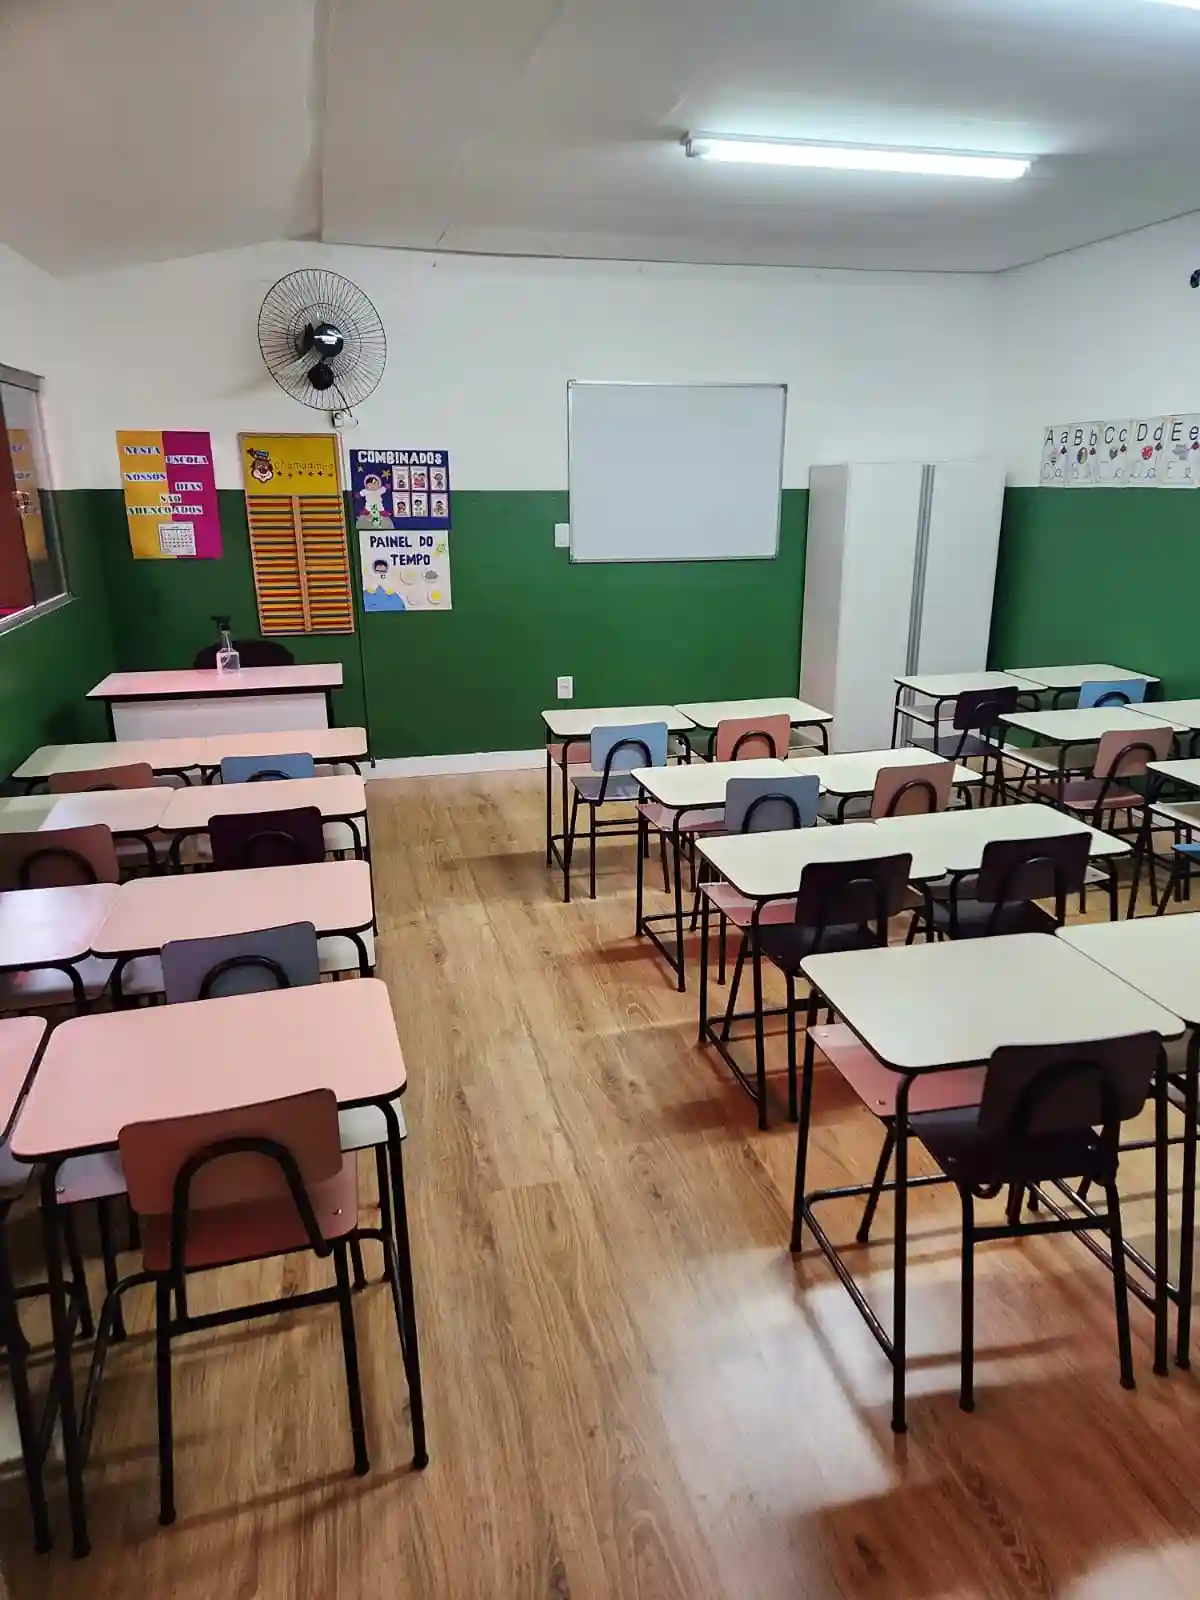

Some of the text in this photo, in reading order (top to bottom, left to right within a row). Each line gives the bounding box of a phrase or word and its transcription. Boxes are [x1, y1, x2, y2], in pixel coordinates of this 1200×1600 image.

[1044, 429, 1069, 447] A a
[1073, 428, 1098, 446] B b
[1104, 426, 1127, 444] C c
[1136, 422, 1164, 441] D d
[1171, 422, 1199, 441] E e
[166, 455, 208, 464] ESCOLA
[357, 450, 443, 465] COMBINADOS
[126, 473, 166, 481] NOSSOS
[176, 483, 202, 491] DIAS
[369, 535, 434, 548] PAINEL DO
[390, 553, 431, 566] TEMPO
